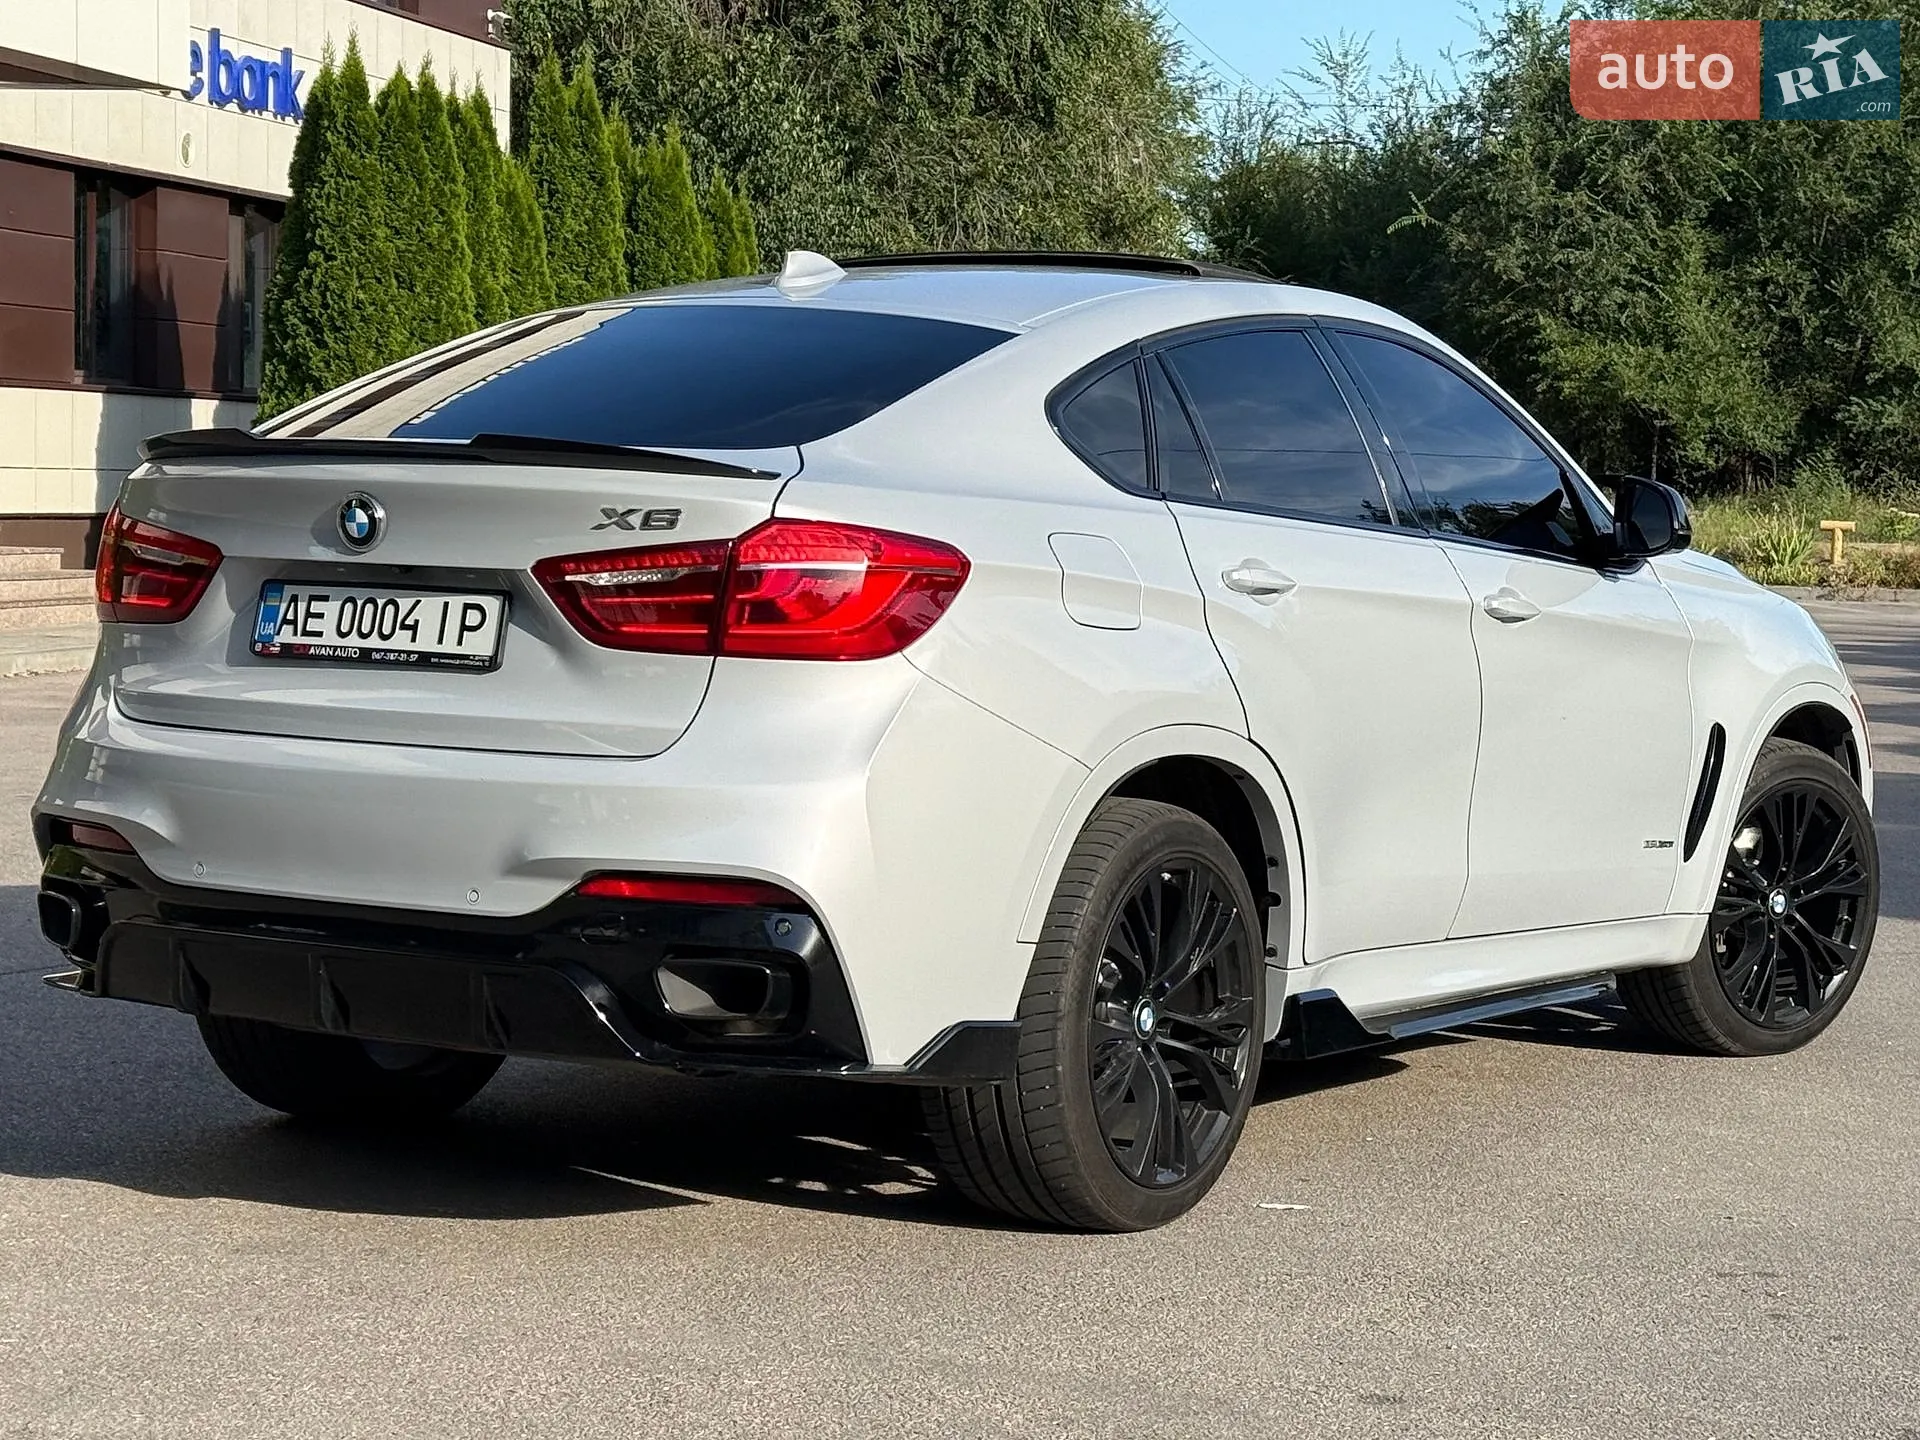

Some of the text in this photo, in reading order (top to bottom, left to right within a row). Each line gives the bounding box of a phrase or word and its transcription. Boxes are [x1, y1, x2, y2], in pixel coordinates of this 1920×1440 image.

[208, 28, 304, 120] bank
[589, 507, 682, 531] X6
[260, 622, 275, 635] UA
[275, 593, 488, 647] AE 0004 IP
[334, 646, 360, 658] AUTO
